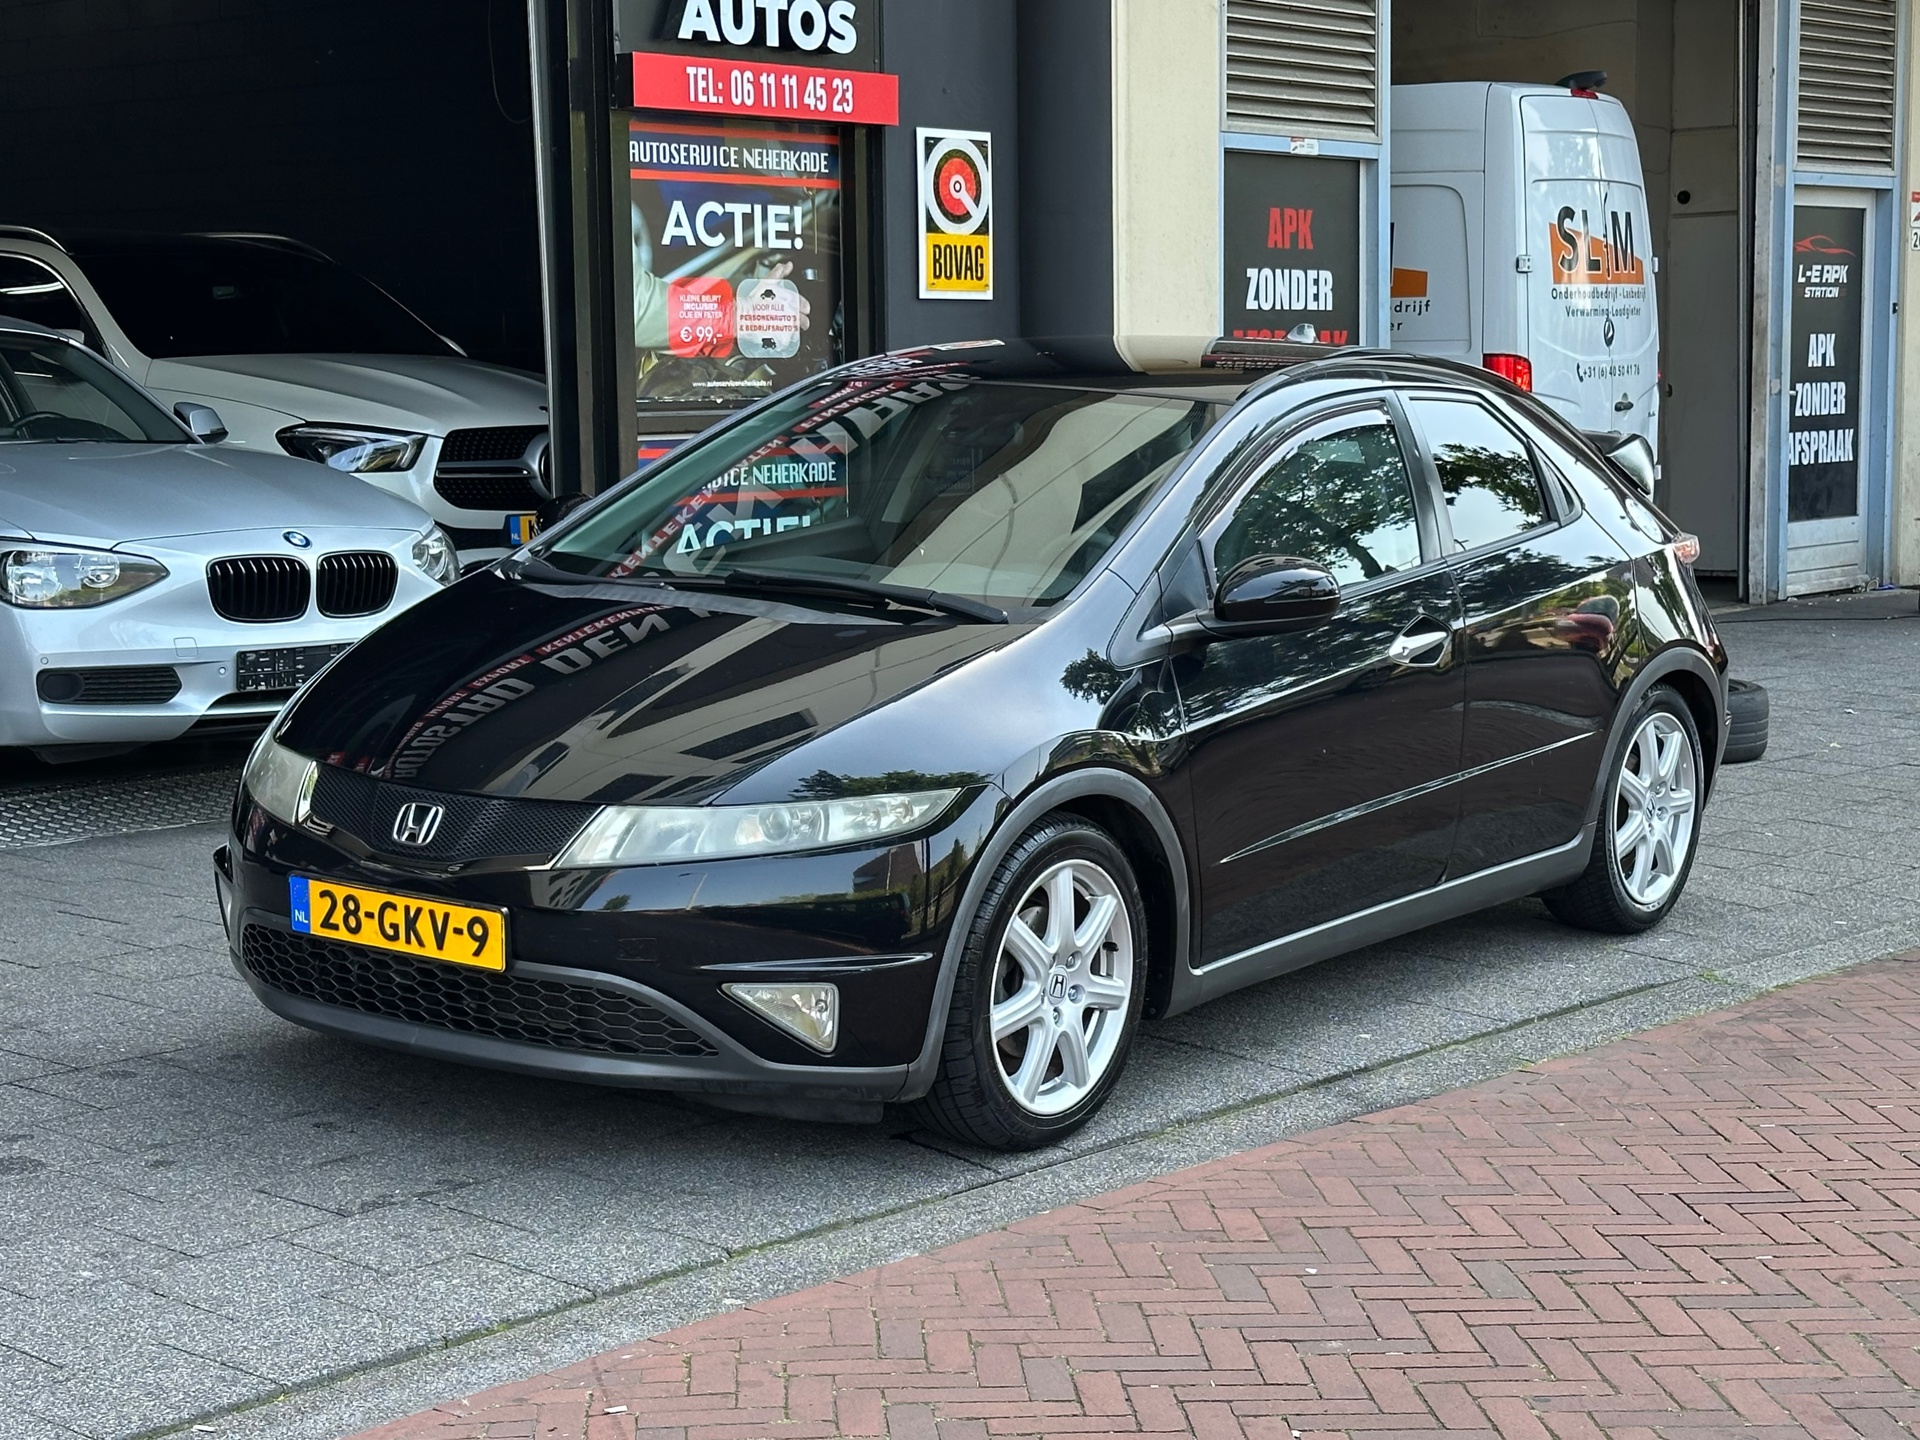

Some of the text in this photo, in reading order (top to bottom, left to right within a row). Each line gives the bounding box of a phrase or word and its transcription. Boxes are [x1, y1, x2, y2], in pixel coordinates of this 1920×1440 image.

[678, 0, 857, 54] AUTOS
[686, 66, 853, 114] TEL: 06 11 11 45 23
[629, 140, 829, 173] AUTOSERVICE NEHERKADE
[661, 200, 804, 250] ACTIE!
[1267, 207, 1314, 250] APK
[1913, 231, 1920, 249] 2
[932, 244, 984, 281] BOVAG
[1823, 264, 1848, 283] APK
[679, 294, 722, 302] KLEINE BEURT
[1245, 267, 1333, 311] ZONDER
[1551, 287, 1617, 302] Onderhoudbedrijf
[1804, 286, 1839, 298] STATION
[679, 311, 723, 319] OLIE EN FILTER
[683, 302, 719, 311] INCLUSIEF
[752, 303, 785, 311] VOOR ALLE
[740, 314, 797, 322] PERSONENAUTO'S
[680, 326, 723, 344] € 99,-
[745, 324, 798, 332] BEDRIJFSAUTO'S
[1807, 333, 1836, 368] APK
[1582, 363, 1640, 380] +31 (6) 40 50 41 76
[1795, 381, 1846, 416] ZONDER
[1788, 428, 1854, 466] AFSPRAAK
[511, 532, 520, 540] NL
[294, 909, 309, 924] NL
[318, 889, 489, 957] 28-GKV-9
